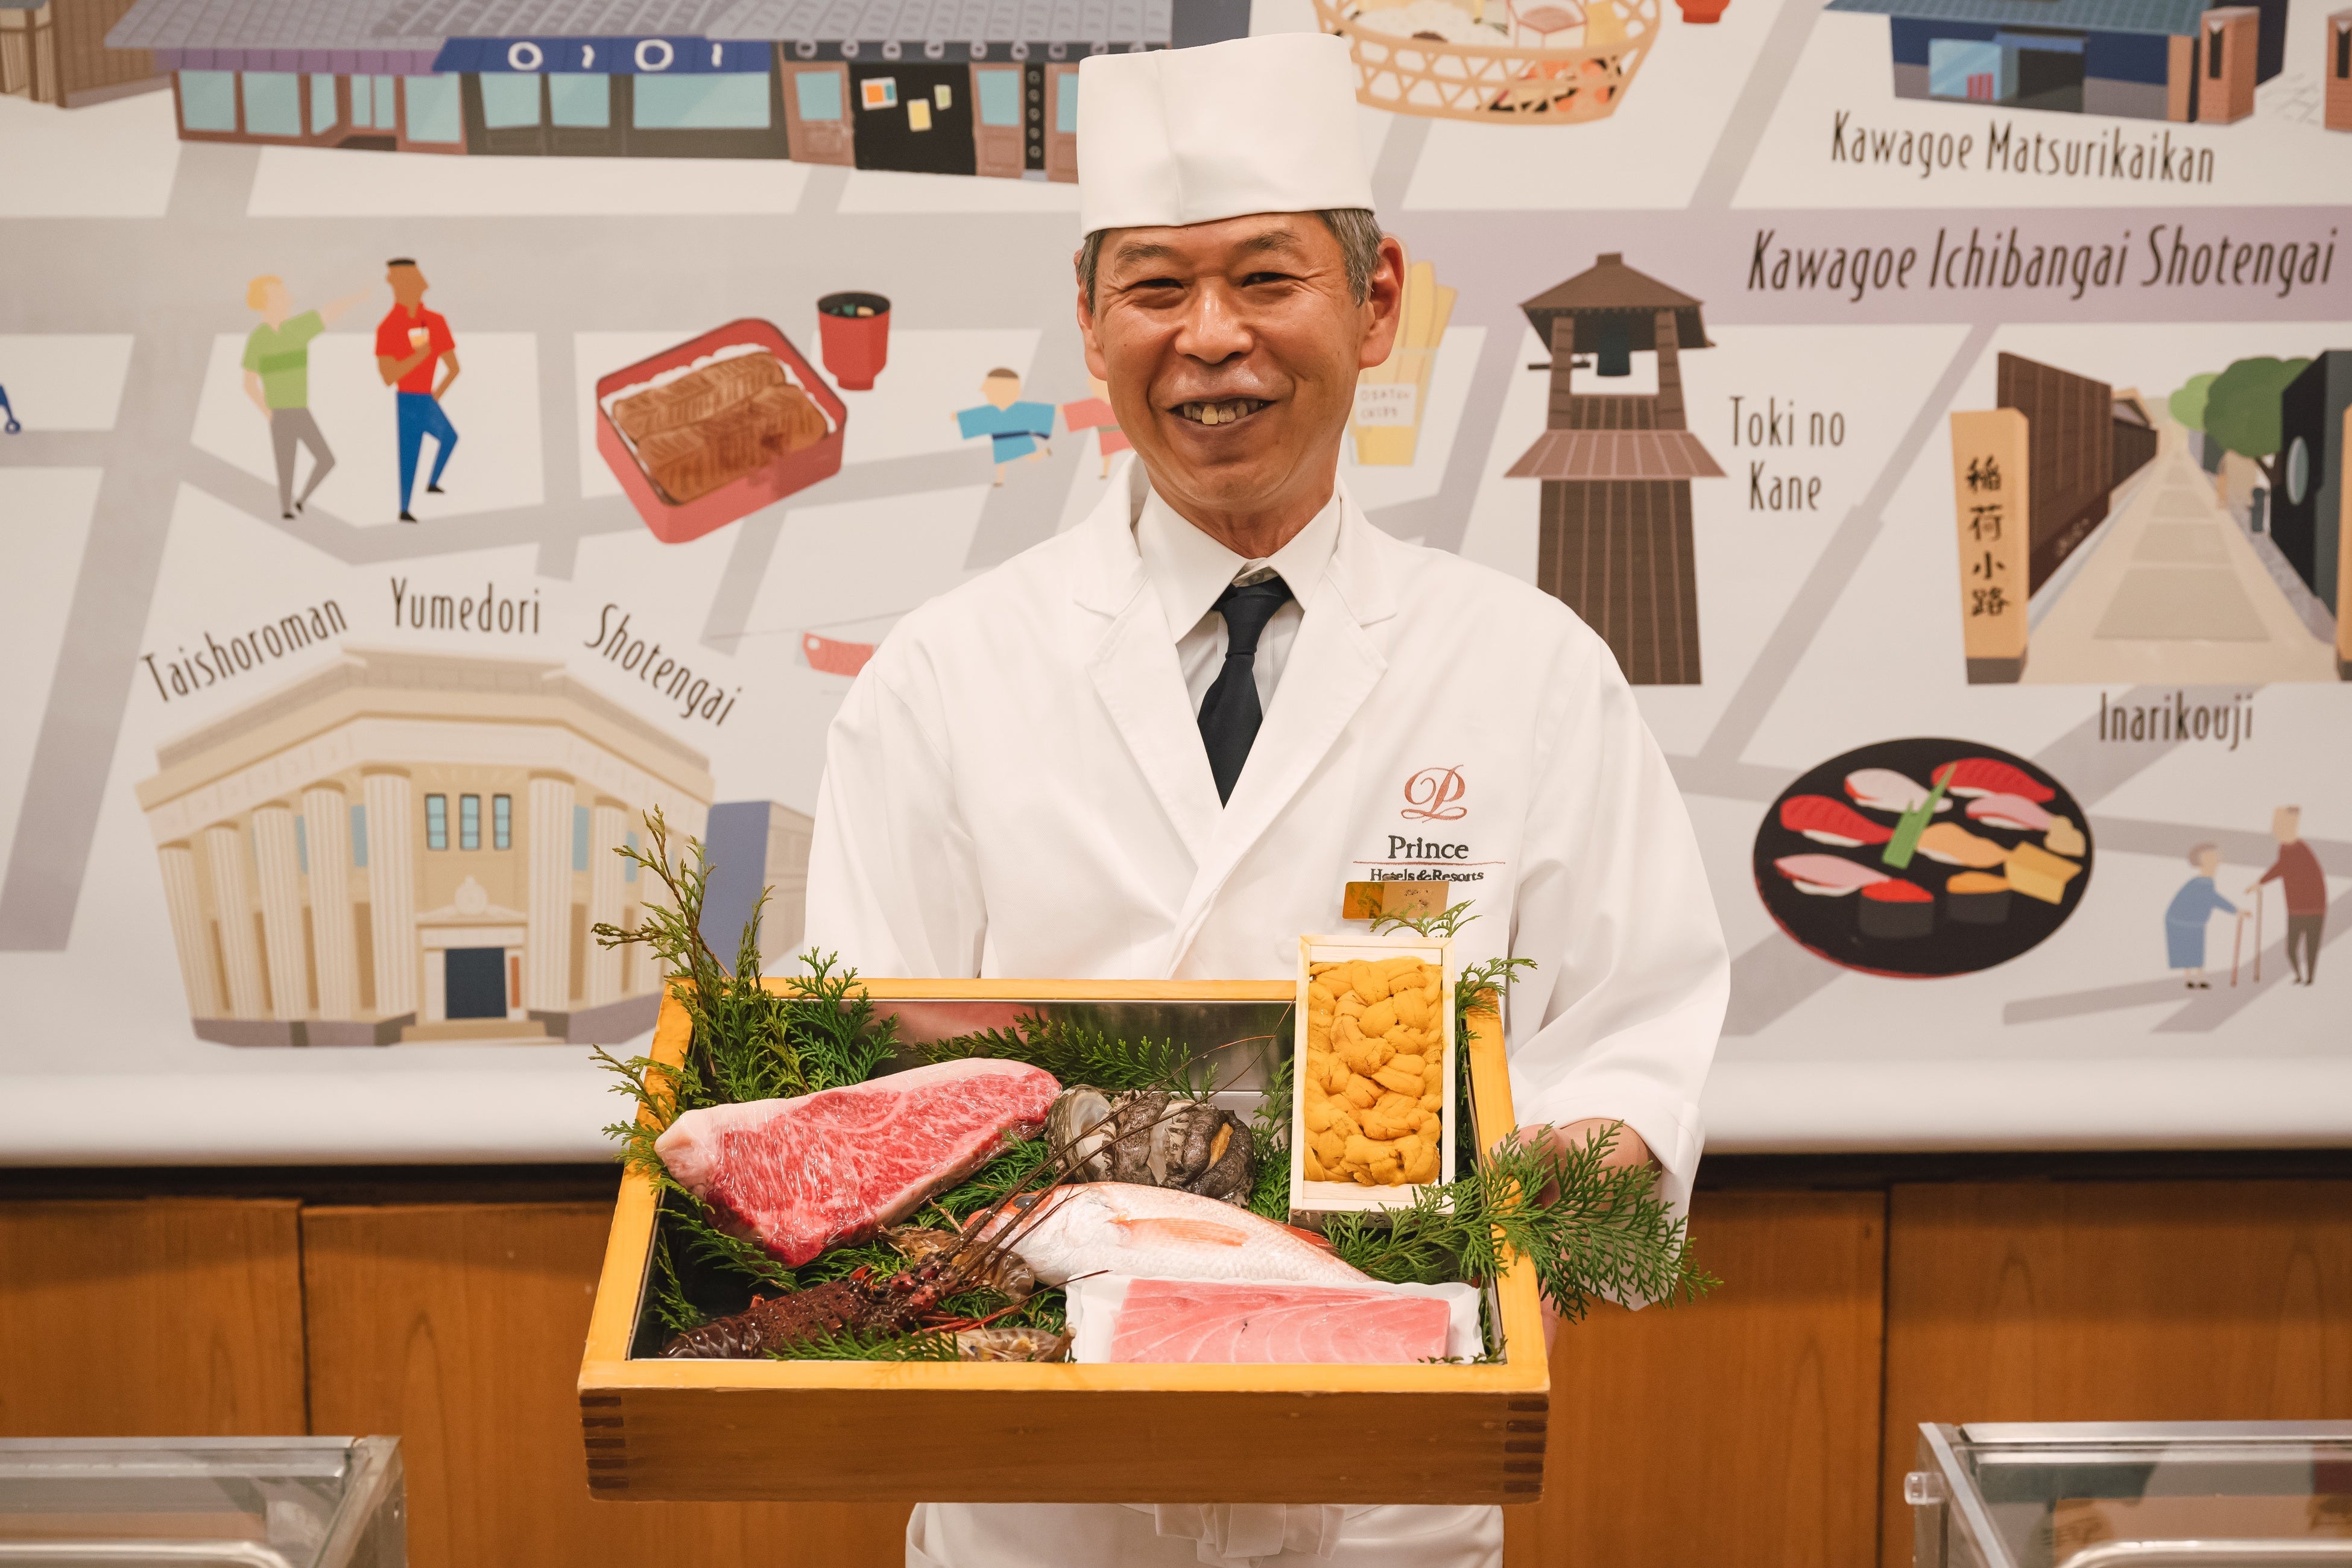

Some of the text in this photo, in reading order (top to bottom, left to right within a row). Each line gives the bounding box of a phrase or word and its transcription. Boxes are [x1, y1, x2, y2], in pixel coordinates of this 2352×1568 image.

[1831, 110, 2214, 184] Kawagoe Matsurikaikan
[1747, 224, 2338, 303] Kawagoe Ichibangai Shotengai
[1730, 396, 1845, 447] Toki no
[1750, 461, 1821, 511] Kane
[1964, 454, 2009, 618] 稲荷小路
[141, 577, 743, 726] Taishoroman Yumedori Shotengai
[2099, 691, 2253, 751] Inarikouji
[1370, 868, 1415, 881] Hels
[1387, 834, 1470, 859] Prince
